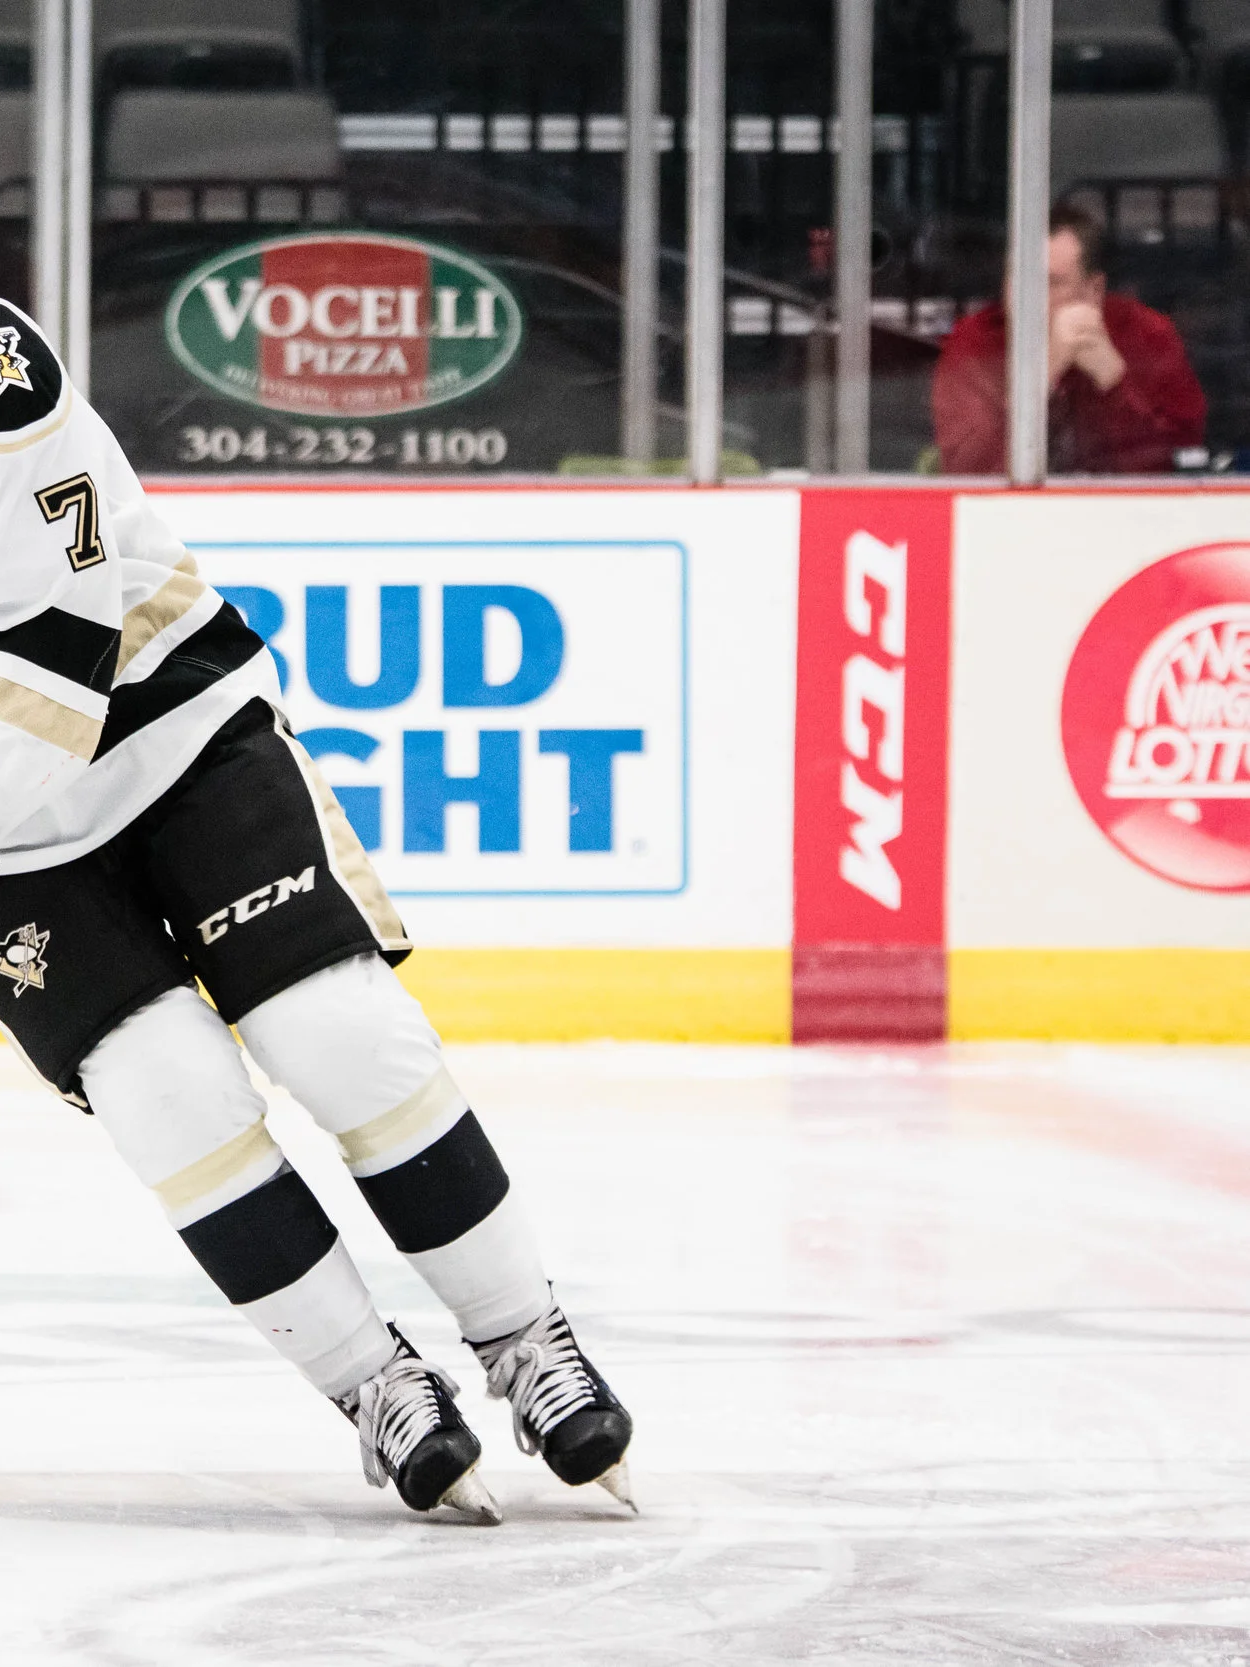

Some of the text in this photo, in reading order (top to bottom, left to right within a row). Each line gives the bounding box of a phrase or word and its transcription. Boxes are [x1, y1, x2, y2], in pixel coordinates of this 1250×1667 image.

[201, 277, 501, 341] VOCELLI
[283, 341, 409, 376] PIZZA
[181, 426, 509, 464] 304-232-1100
[34, 471, 107, 573] 7
[213, 584, 566, 710] UD
[840, 529, 908, 910] CCM
[1108, 724, 1250, 784] LOTT
[196, 866, 315, 945] CCM
